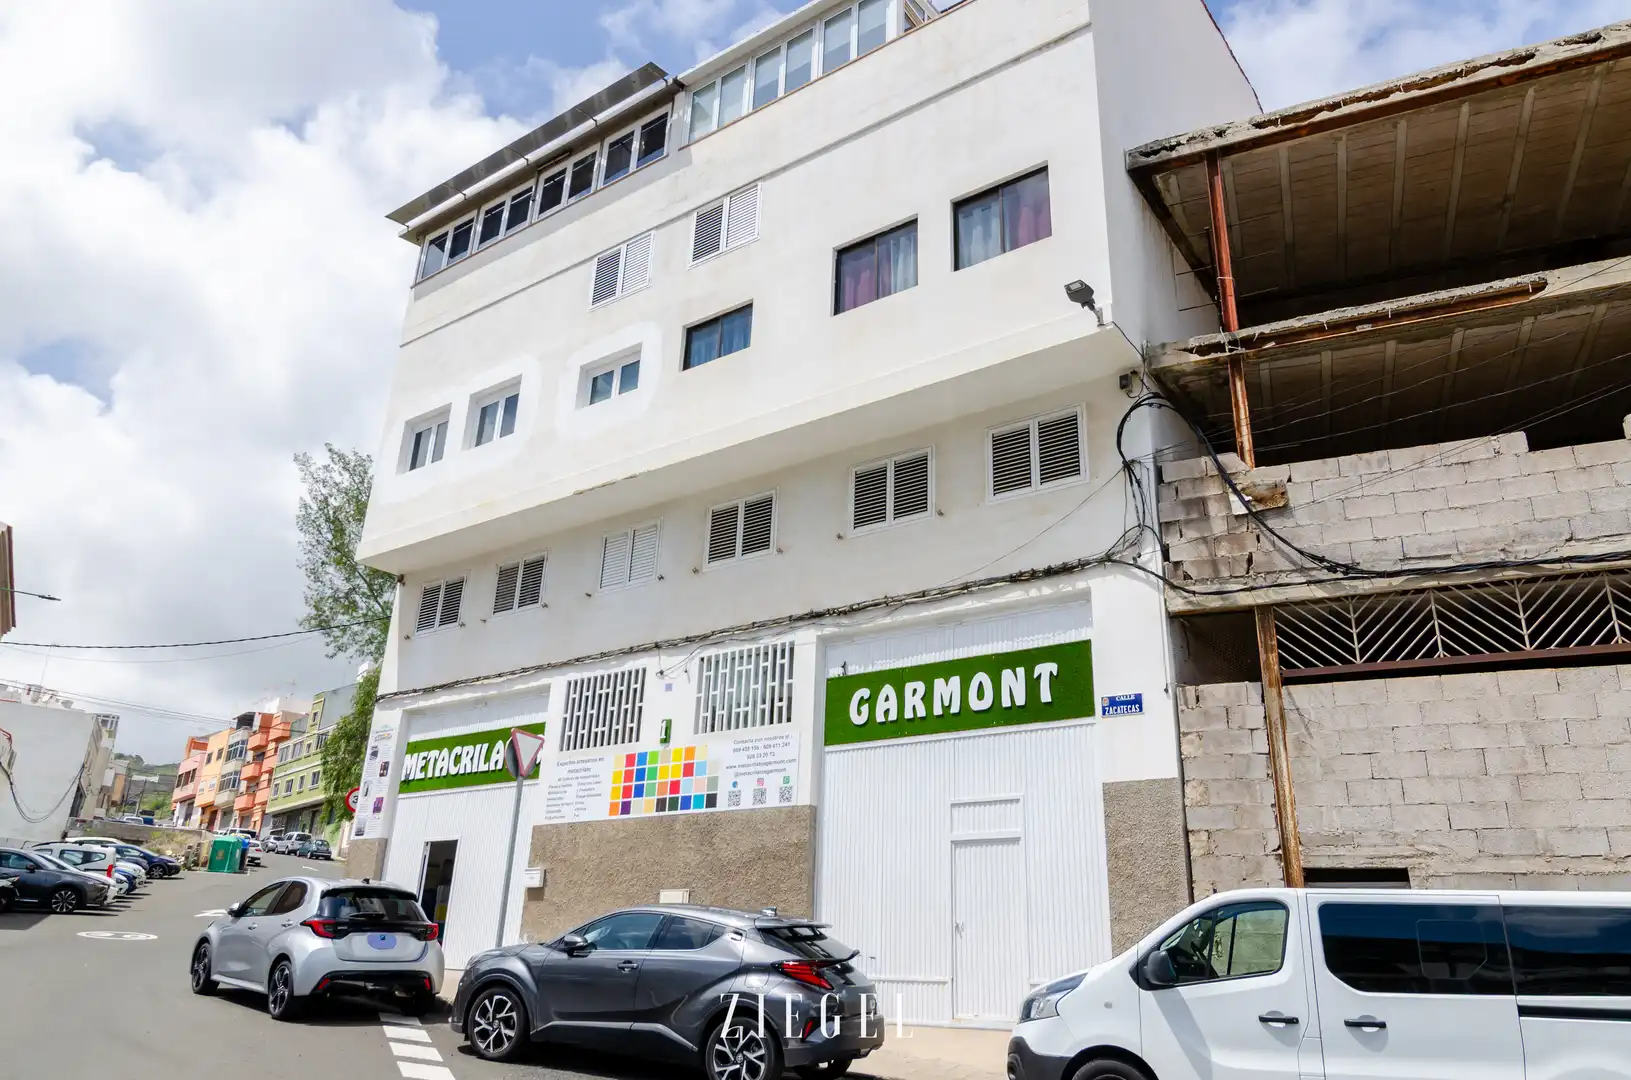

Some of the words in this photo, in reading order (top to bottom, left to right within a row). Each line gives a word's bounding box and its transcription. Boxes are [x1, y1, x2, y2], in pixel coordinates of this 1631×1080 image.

[849, 662, 1058, 726] GARMONT
[1104, 704, 1140, 715] ZACATECAS
[400, 734, 545, 781] METACRILA
